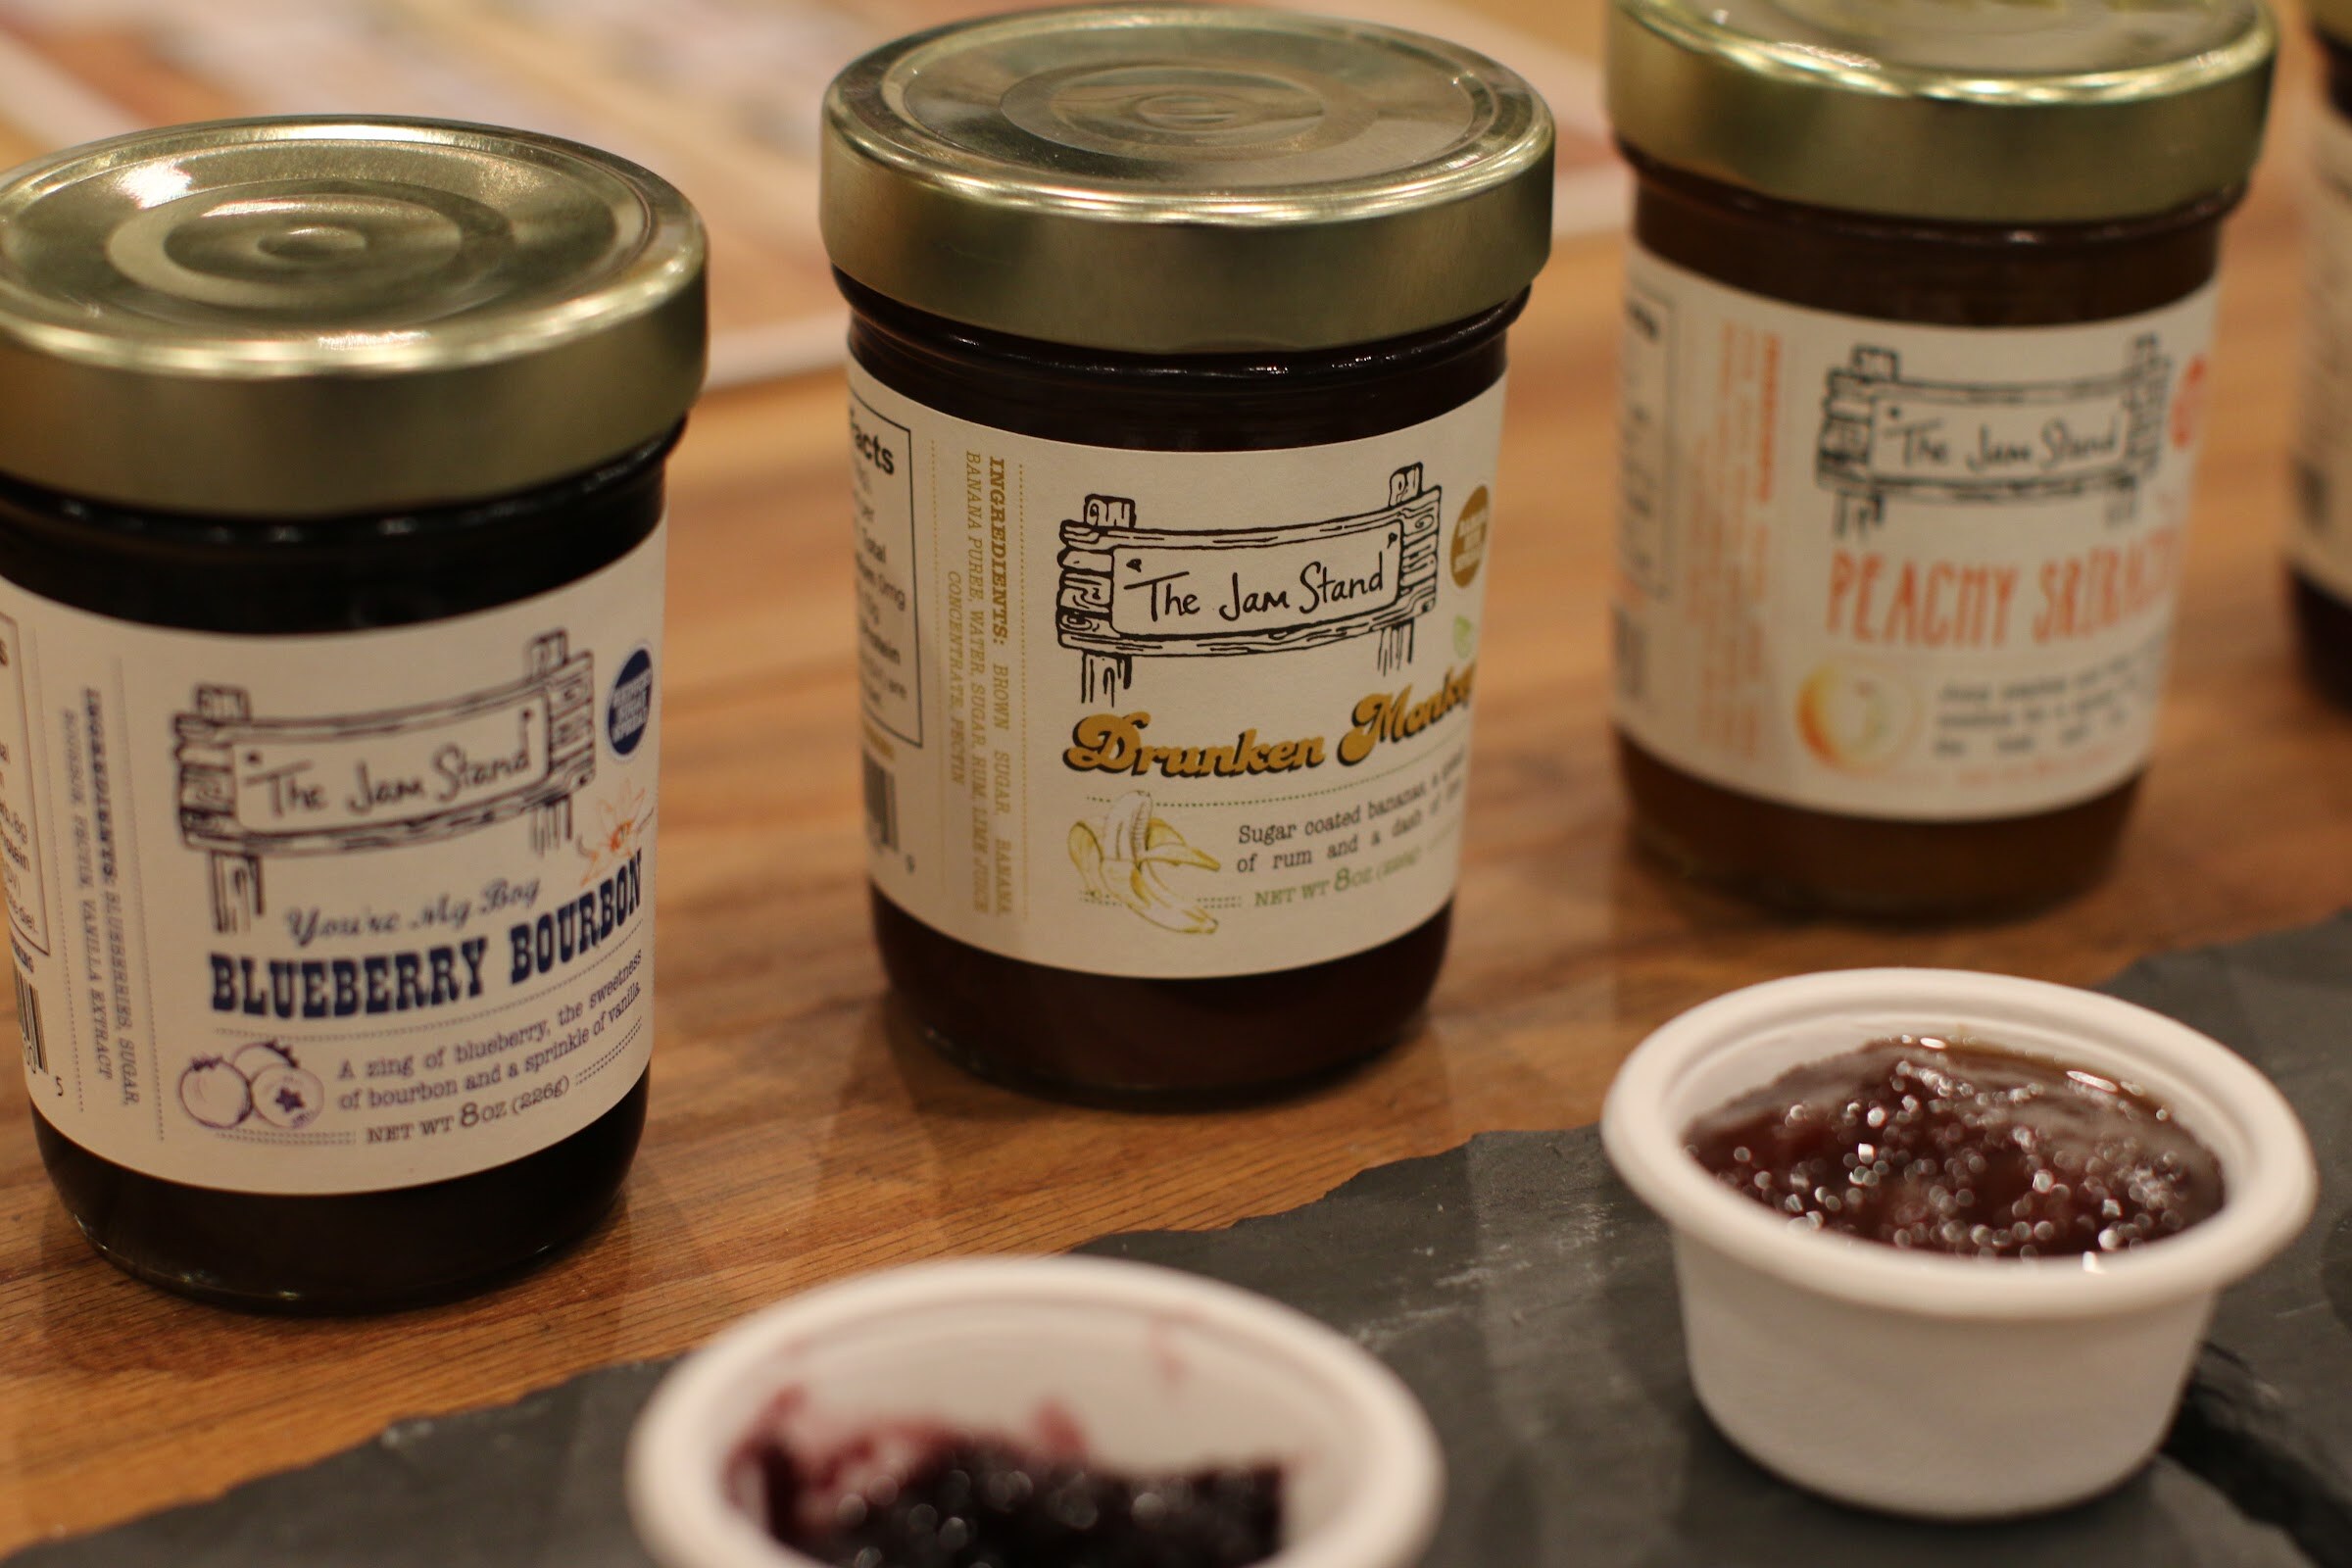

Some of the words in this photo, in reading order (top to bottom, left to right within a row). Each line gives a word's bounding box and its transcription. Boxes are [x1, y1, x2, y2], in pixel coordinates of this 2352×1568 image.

[1884, 419, 1950, 468] The
[1966, 423, 2033, 473] Jam
[2041, 412, 2119, 470] Stand
[966, 450, 982, 529] BANANA
[967, 536, 984, 601] PUREE,
[990, 456, 1008, 645] INGREDIENTS:
[1124, 570, 1200, 622] The
[1219, 572, 1292, 622] Jam
[1299, 551, 1385, 615] Stand
[1827, 549, 2018, 649] PEACHY
[968, 610, 985, 676] WATER,
[993, 662, 1009, 730] BROWN
[241, 758, 328, 819] The
[345, 758, 423, 816] Jam
[431, 723, 531, 804] Stand
[1062, 710, 1327, 778] Drunken
[1237, 853, 1257, 873] of
[1272, 850, 1313, 869] rum
[1326, 835, 1358, 859] and
[1370, 831, 1381, 847] a
[1238, 824, 1298, 846] Sugar
[1304, 805, 1361, 836] coated
[284, 904, 401, 949] You're
[408, 891, 472, 929] My
[478, 876, 541, 914] Boy
[1253, 885, 1297, 908] NET
[1301, 879, 1330, 900] WT
[80, 899, 103, 982] VANILLA
[209, 936, 489, 1020] BLUEBERRY
[509, 845, 643, 986] BOURBON
[89, 987, 113, 1080] EXTRACT
[336, 1058, 356, 1080] A
[367, 1053, 414, 1080] zing
[424, 1045, 449, 1070] of
[454, 1017, 552, 1064] blueberry,
[557, 998, 583, 1027] the
[588, 947, 643, 1009] sweetness
[119, 1037, 140, 1106] SUGAR,
[337, 1089, 363, 1111] of
[368, 1074, 459, 1109] bourbon
[465, 1066, 503, 1093] and
[507, 1062, 519, 1080] a
[524, 1027, 590, 1075] sprinkle
[593, 1008, 608, 1037] of
[366, 1125, 416, 1146] NET
[418, 1115, 455, 1138] WT
[513, 1073, 570, 1116] (226g)
